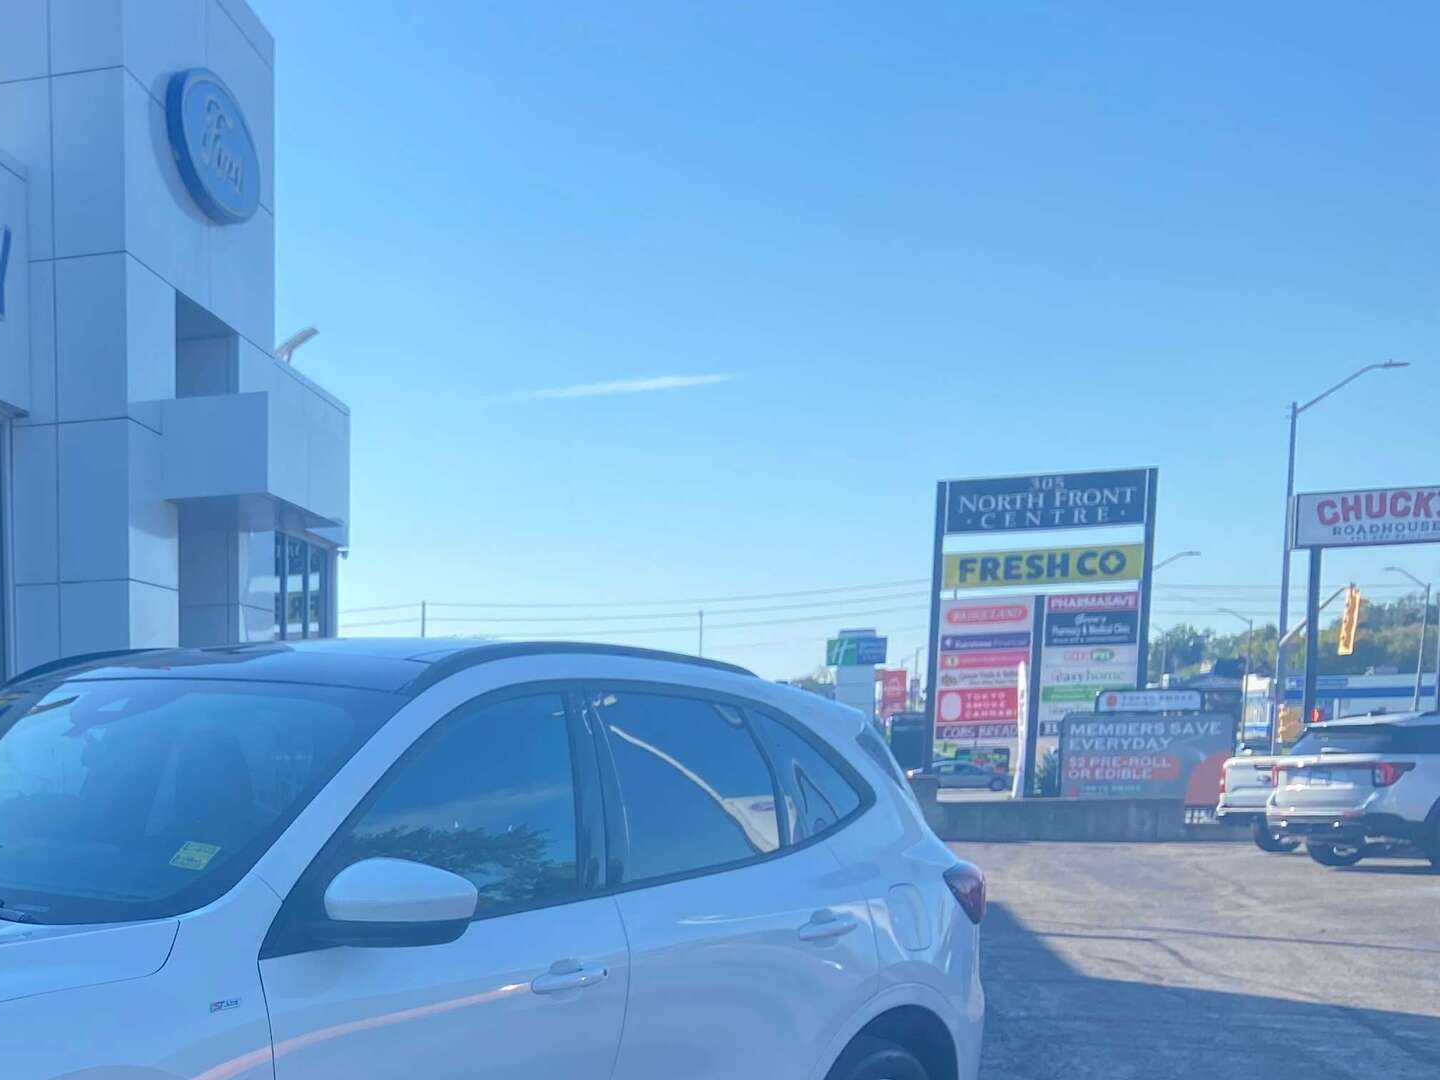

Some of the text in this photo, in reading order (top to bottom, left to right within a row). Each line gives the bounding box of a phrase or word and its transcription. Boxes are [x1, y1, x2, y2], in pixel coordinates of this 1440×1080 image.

[1029, 475, 1065, 491] 305
[959, 486, 1137, 513] NORTH FRONT
[1317, 490, 1440, 526] CHUCK
[980, 506, 1110, 529] CENTRE
[1332, 521, 1440, 536] ROADHOUSE
[964, 708, 1017, 719] CANNABI
[1069, 722, 1165, 736] MEMBERS
[1169, 720, 1222, 735] SAVE
[1069, 737, 1173, 750] EVERYDAY
[1068, 768, 1153, 780] OR EDIBLE
